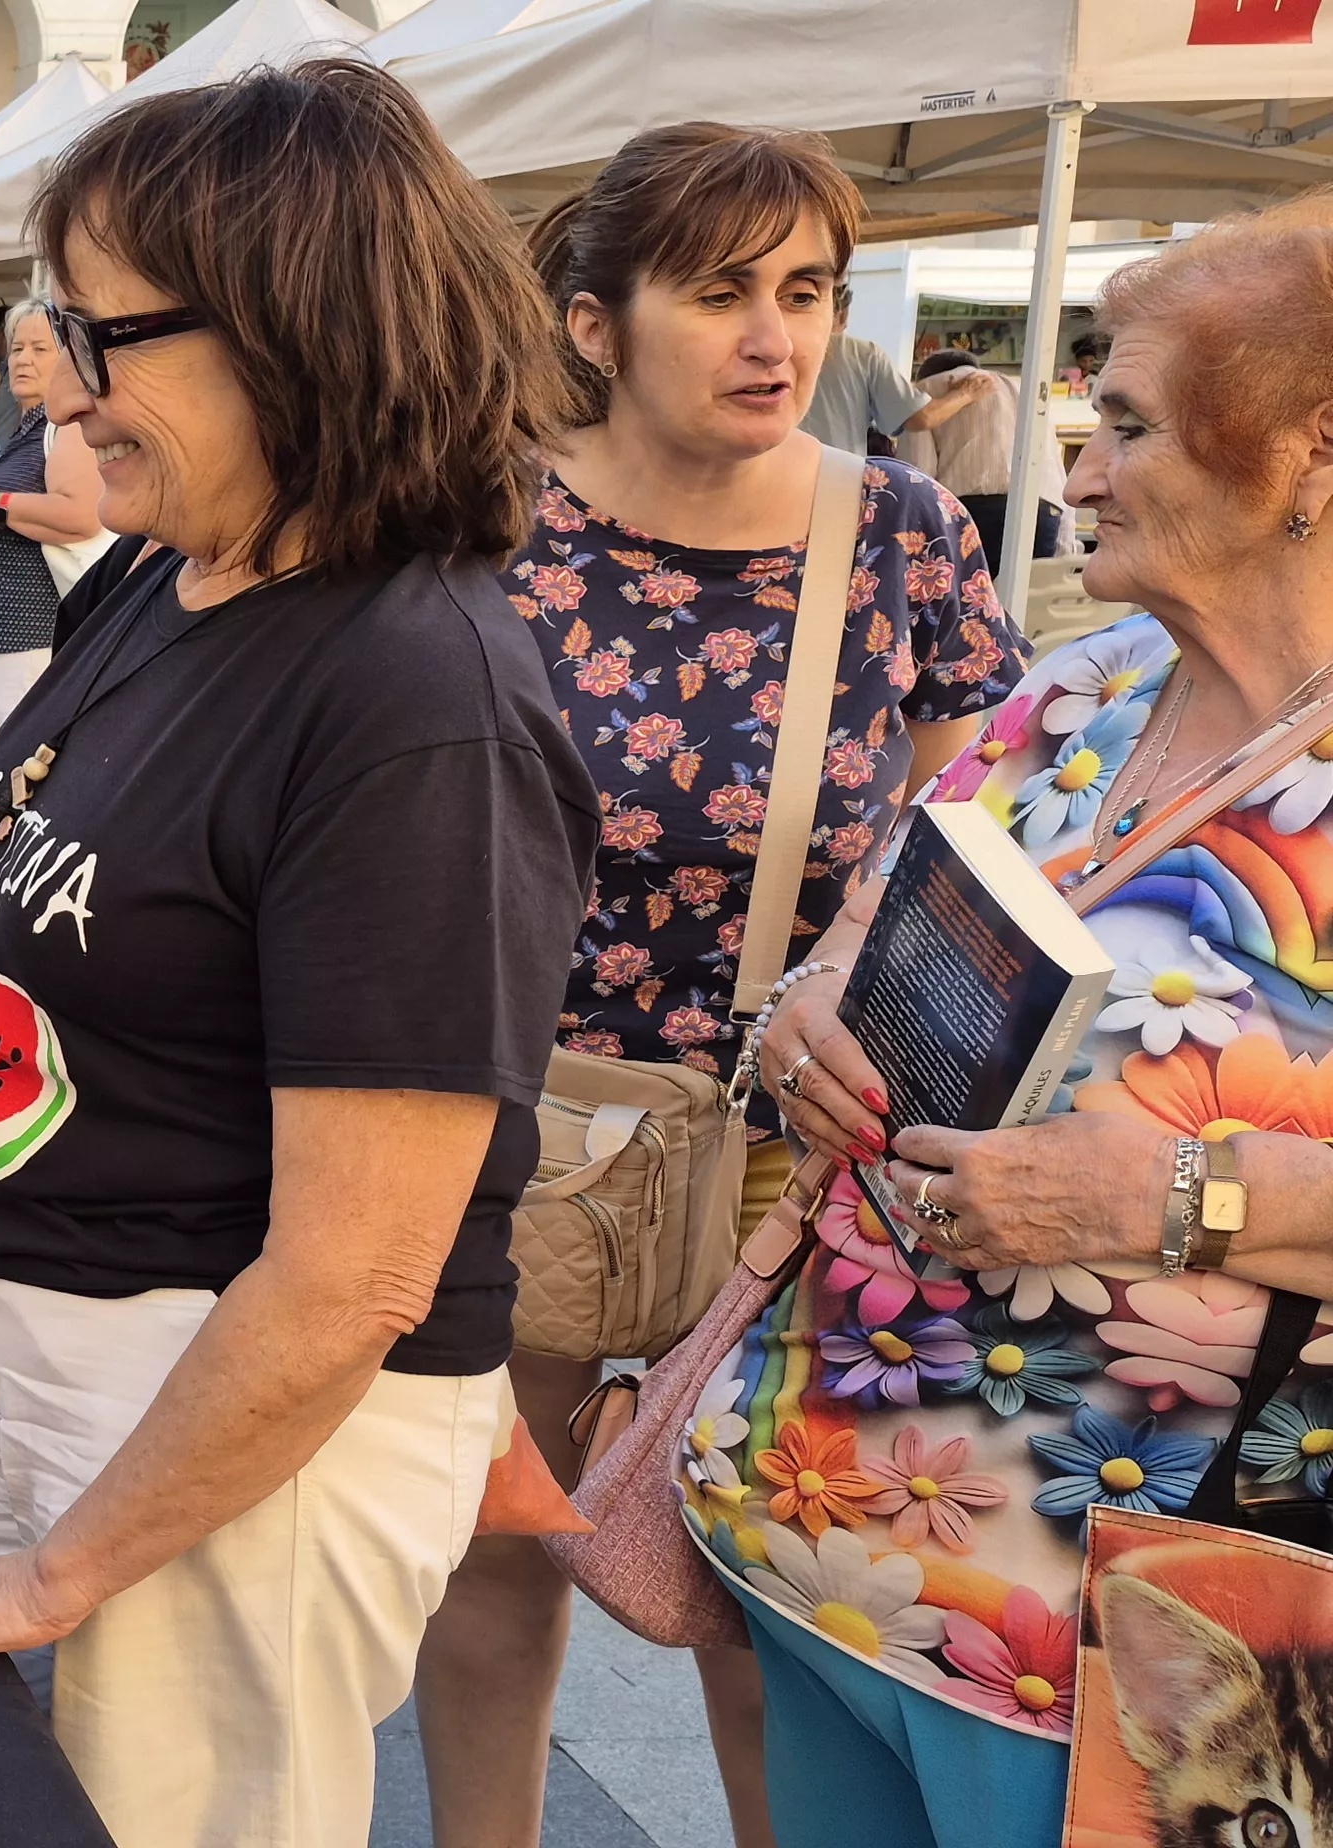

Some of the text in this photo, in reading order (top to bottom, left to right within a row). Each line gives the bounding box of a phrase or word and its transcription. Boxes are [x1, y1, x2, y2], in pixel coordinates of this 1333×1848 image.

[920, 96, 975, 112] MASTERTENT
[1064, 997, 1089, 1028] PLANA
[1023, 1069, 1052, 1117] AQUILES
